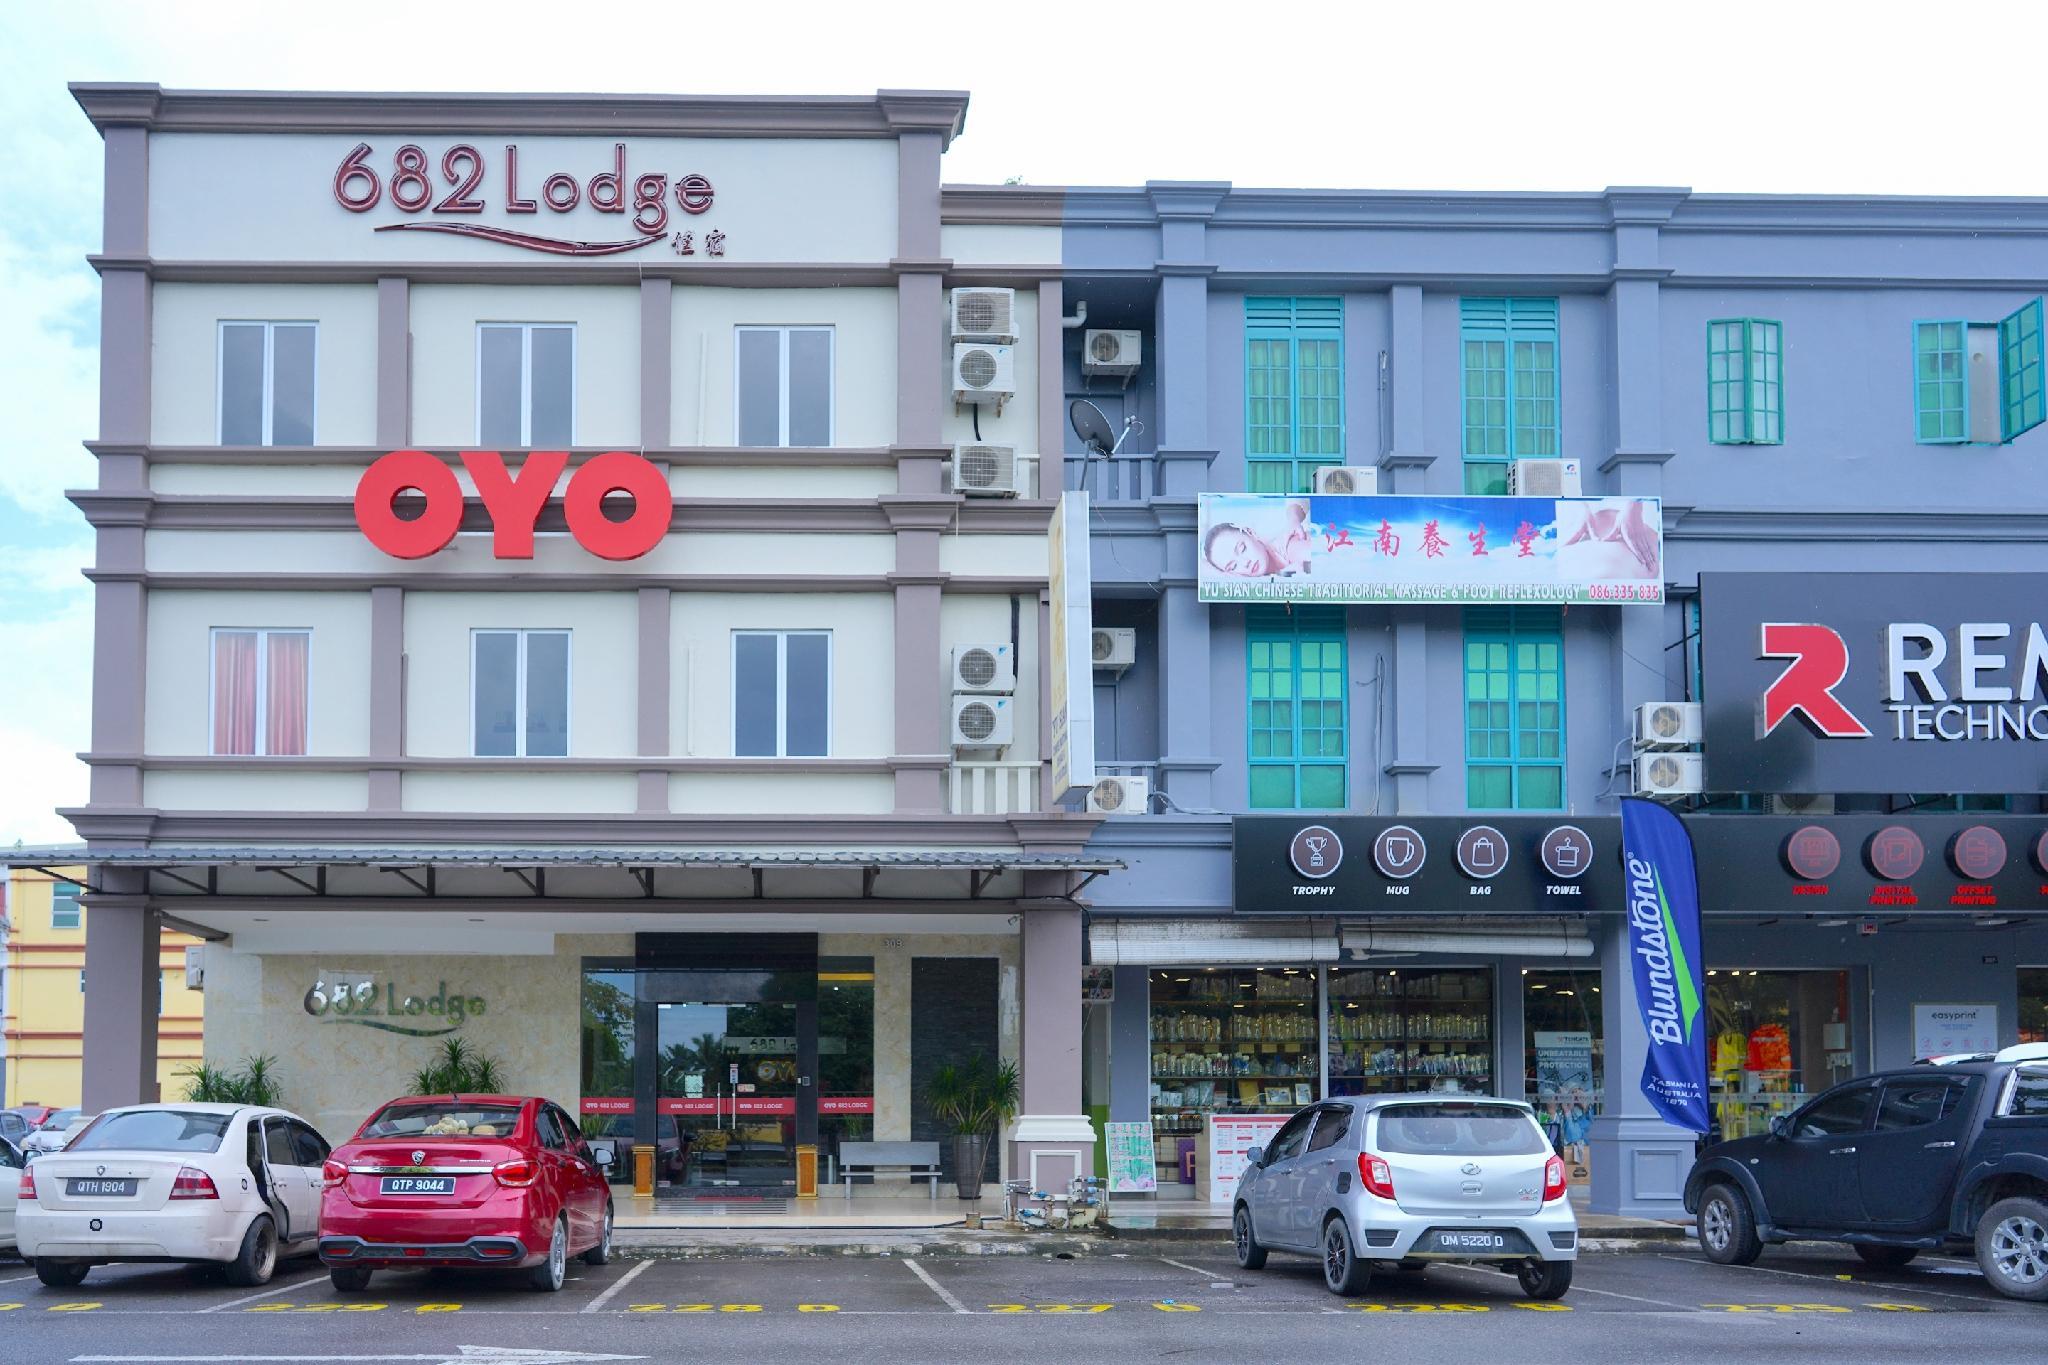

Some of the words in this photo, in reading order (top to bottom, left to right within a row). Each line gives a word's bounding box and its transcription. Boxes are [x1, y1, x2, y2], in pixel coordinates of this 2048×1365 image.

[333, 142, 486, 214] 682
[505, 143, 716, 236] Lodge
[354, 449, 673, 561] OYO
[1326, 519, 1540, 558] 江南養生堂
[1203, 582, 1219, 598] YU
[1223, 582, 1250, 598] SIAN
[1254, 582, 1304, 598] CHINESE
[1393, 583, 1447, 599] MASSAGE
[1451, 583, 1459, 599] &
[1463, 583, 1496, 599] FOOT
[1500, 584, 1582, 600] REFLEXOLOGY
[1638, 585, 1659, 600] 835
[1291, 885, 1337, 896] TROPHY
[1386, 885, 1411, 896] MUG
[1470, 886, 1492, 896] BAG
[1546, 885, 1582, 896] TOWEL
[1792, 885, 1829, 895] DESIGN
[1956, 885, 1993, 895] OFFSET
[1869, 895, 1918, 905] PRINTING
[1950, 895, 1997, 905] PRINTING
[1629, 858, 1683, 1046] Blundstone
[303, 980, 380, 1017] 682
[387, 980, 487, 1026] Lodge
[1931, 1011, 1976, 1021] easyprint
[1652, 1076, 1699, 1089] TASMANIA
[1647, 1083, 1702, 1098] AUSTRALIA
[77, 1181, 99, 1193] QTH
[101, 1181, 125, 1193] 1904
[391, 1179, 414, 1191] QTP
[415, 1179, 445, 1191] 9044
[1461, 1235, 1492, 1247] 5220
[243, 1303, 390, 1312] 229
[626, 1303, 765, 1313] 228
[987, 1303, 1115, 1313] 227
